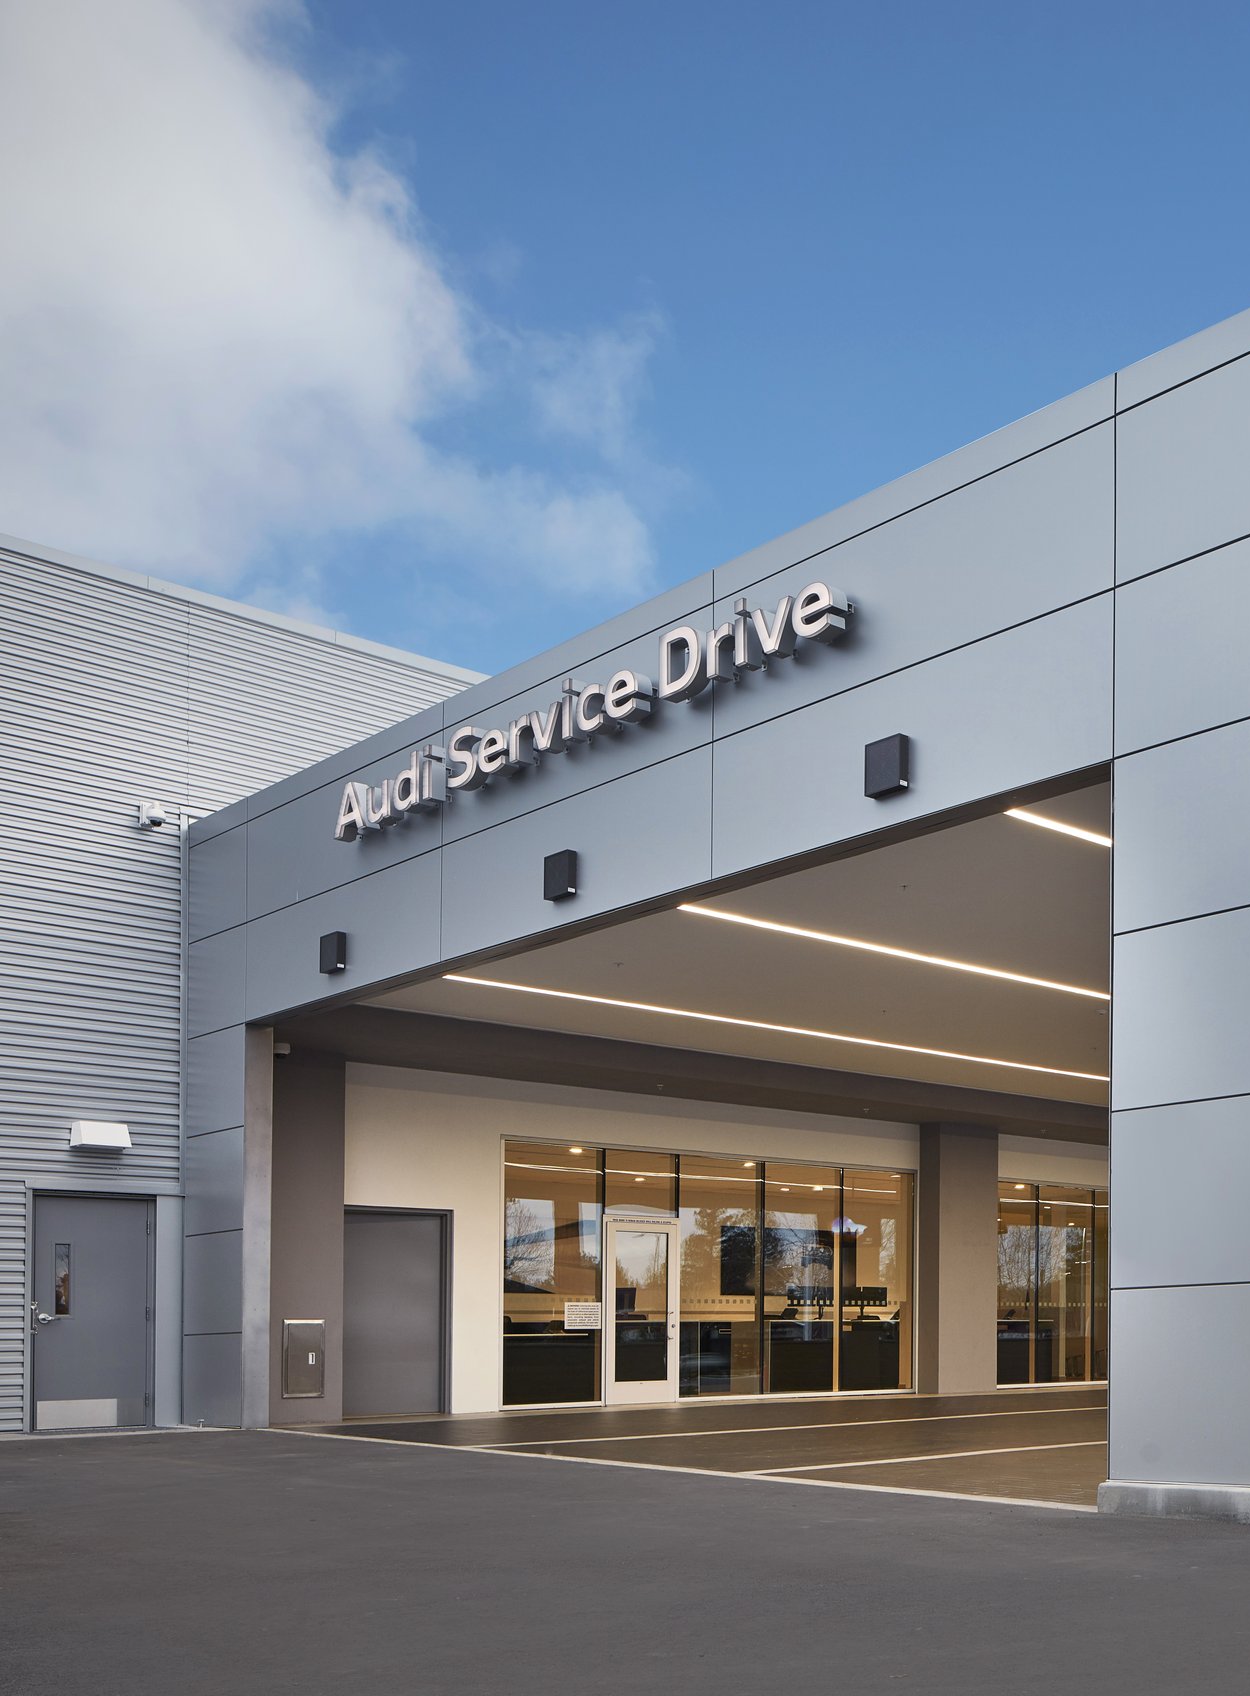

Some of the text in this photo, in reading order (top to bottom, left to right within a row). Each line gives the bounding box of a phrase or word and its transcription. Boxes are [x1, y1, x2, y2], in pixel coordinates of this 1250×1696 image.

[334, 581, 849, 842] Audi Service Drive
